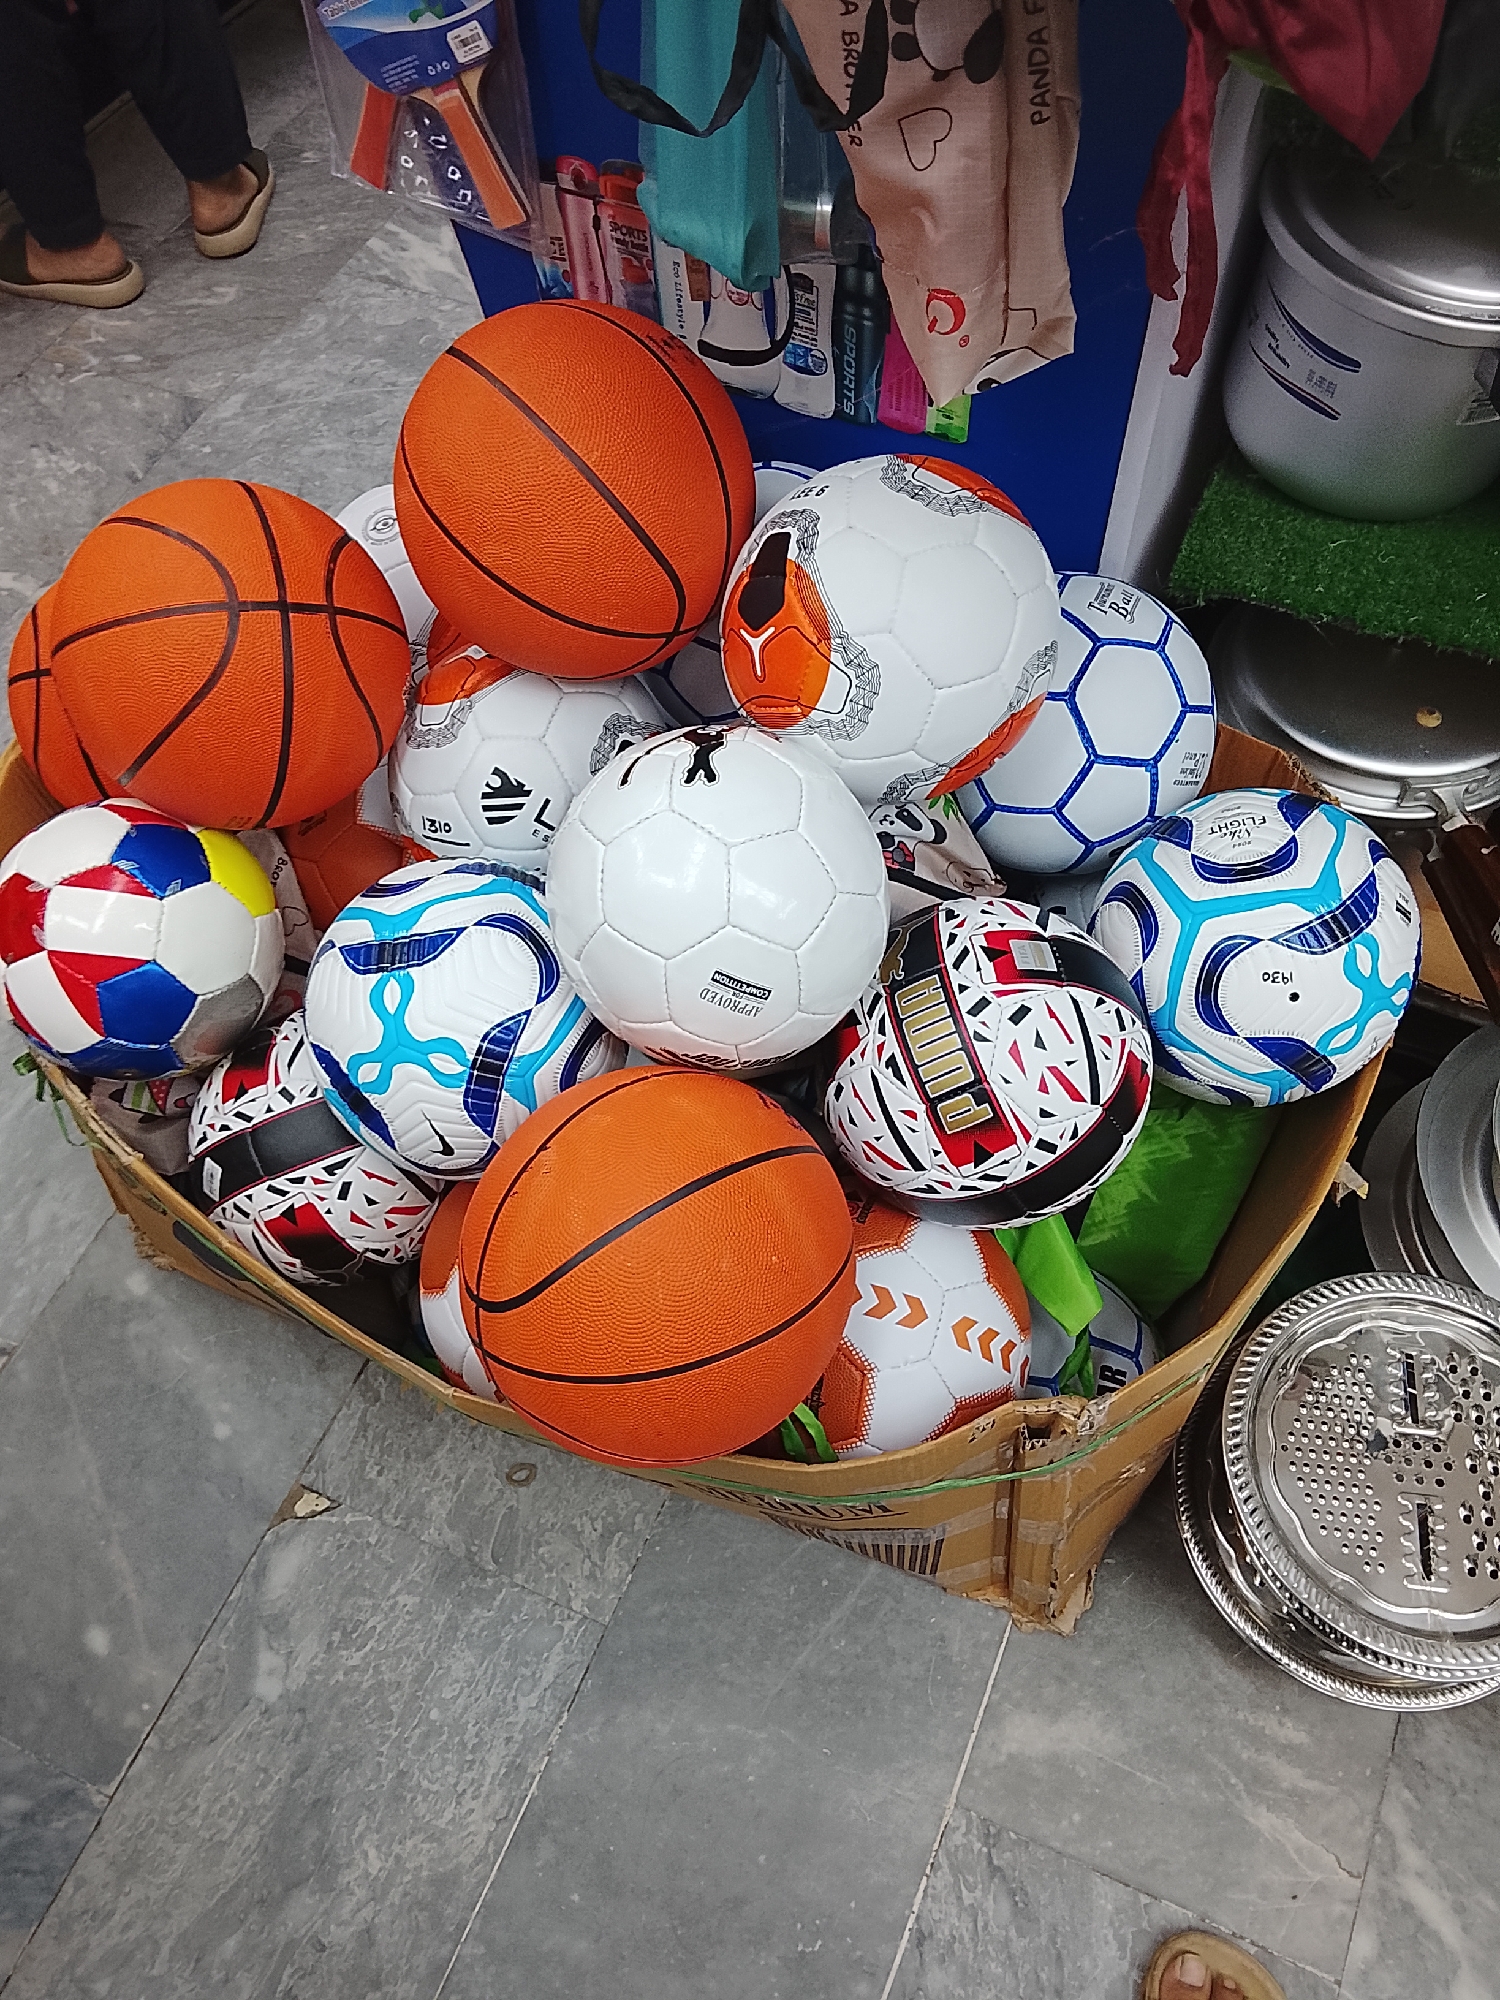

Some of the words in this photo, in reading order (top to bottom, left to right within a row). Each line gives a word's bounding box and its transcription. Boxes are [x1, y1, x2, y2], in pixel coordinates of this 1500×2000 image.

[1027, 26, 1053, 126] PANDA
[843, 323, 857, 416] SPORTS
[814, 484, 830, 497] 6
[421, 815, 452, 834] 1310
[1207, 815, 1268, 836] FLIGHT
[712, 972, 770, 999] COMPETITION
[731, 990, 744, 1000] FOR
[699, 987, 764, 1018] APPROVED
[895, 973, 994, 1135] PUMA
